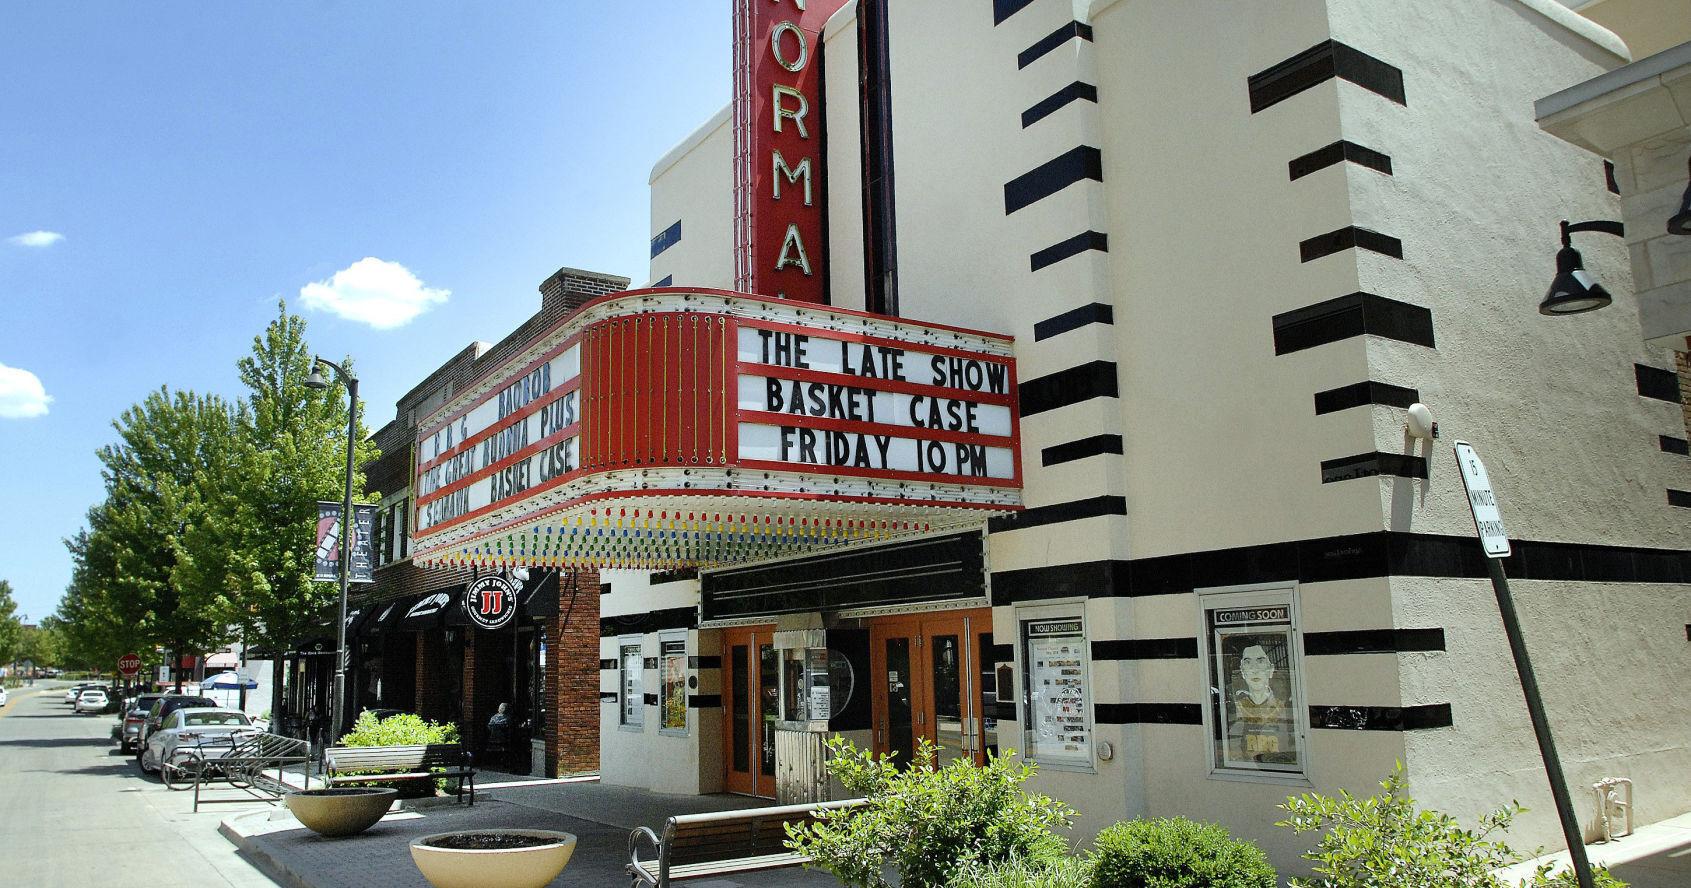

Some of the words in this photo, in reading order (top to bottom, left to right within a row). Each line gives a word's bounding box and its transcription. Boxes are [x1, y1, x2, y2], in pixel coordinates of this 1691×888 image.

[771, 0, 813, 299] ORMA
[758, 329, 809, 369] THE
[841, 341, 907, 382] LATE
[931, 355, 1007, 395] SHOW
[541, 391, 575, 439] PLUS
[766, 376, 877, 423] BASKET
[909, 395, 981, 433] CASE
[781, 426, 890, 470] FRIDAY
[490, 456, 532, 503] BASKET
[539, 437, 574, 483] CASE
[1469, 459, 1478, 476] 15
[1470, 489, 1495, 506] MINUTE
[1479, 520, 1505, 537] PARKING
[354, 508, 370, 579] THEATER
[470, 579, 490, 603] JIMMY
[492, 579, 514, 603] JOHN'S
[480, 590, 503, 615] JJ
[1219, 609, 1256, 622] COMING
[1256, 608, 1285, 620] SOON
[1035, 624, 1049, 634] NOW
[1050, 622, 1079, 633] SHOWING
[120, 660, 140, 670] STOP
